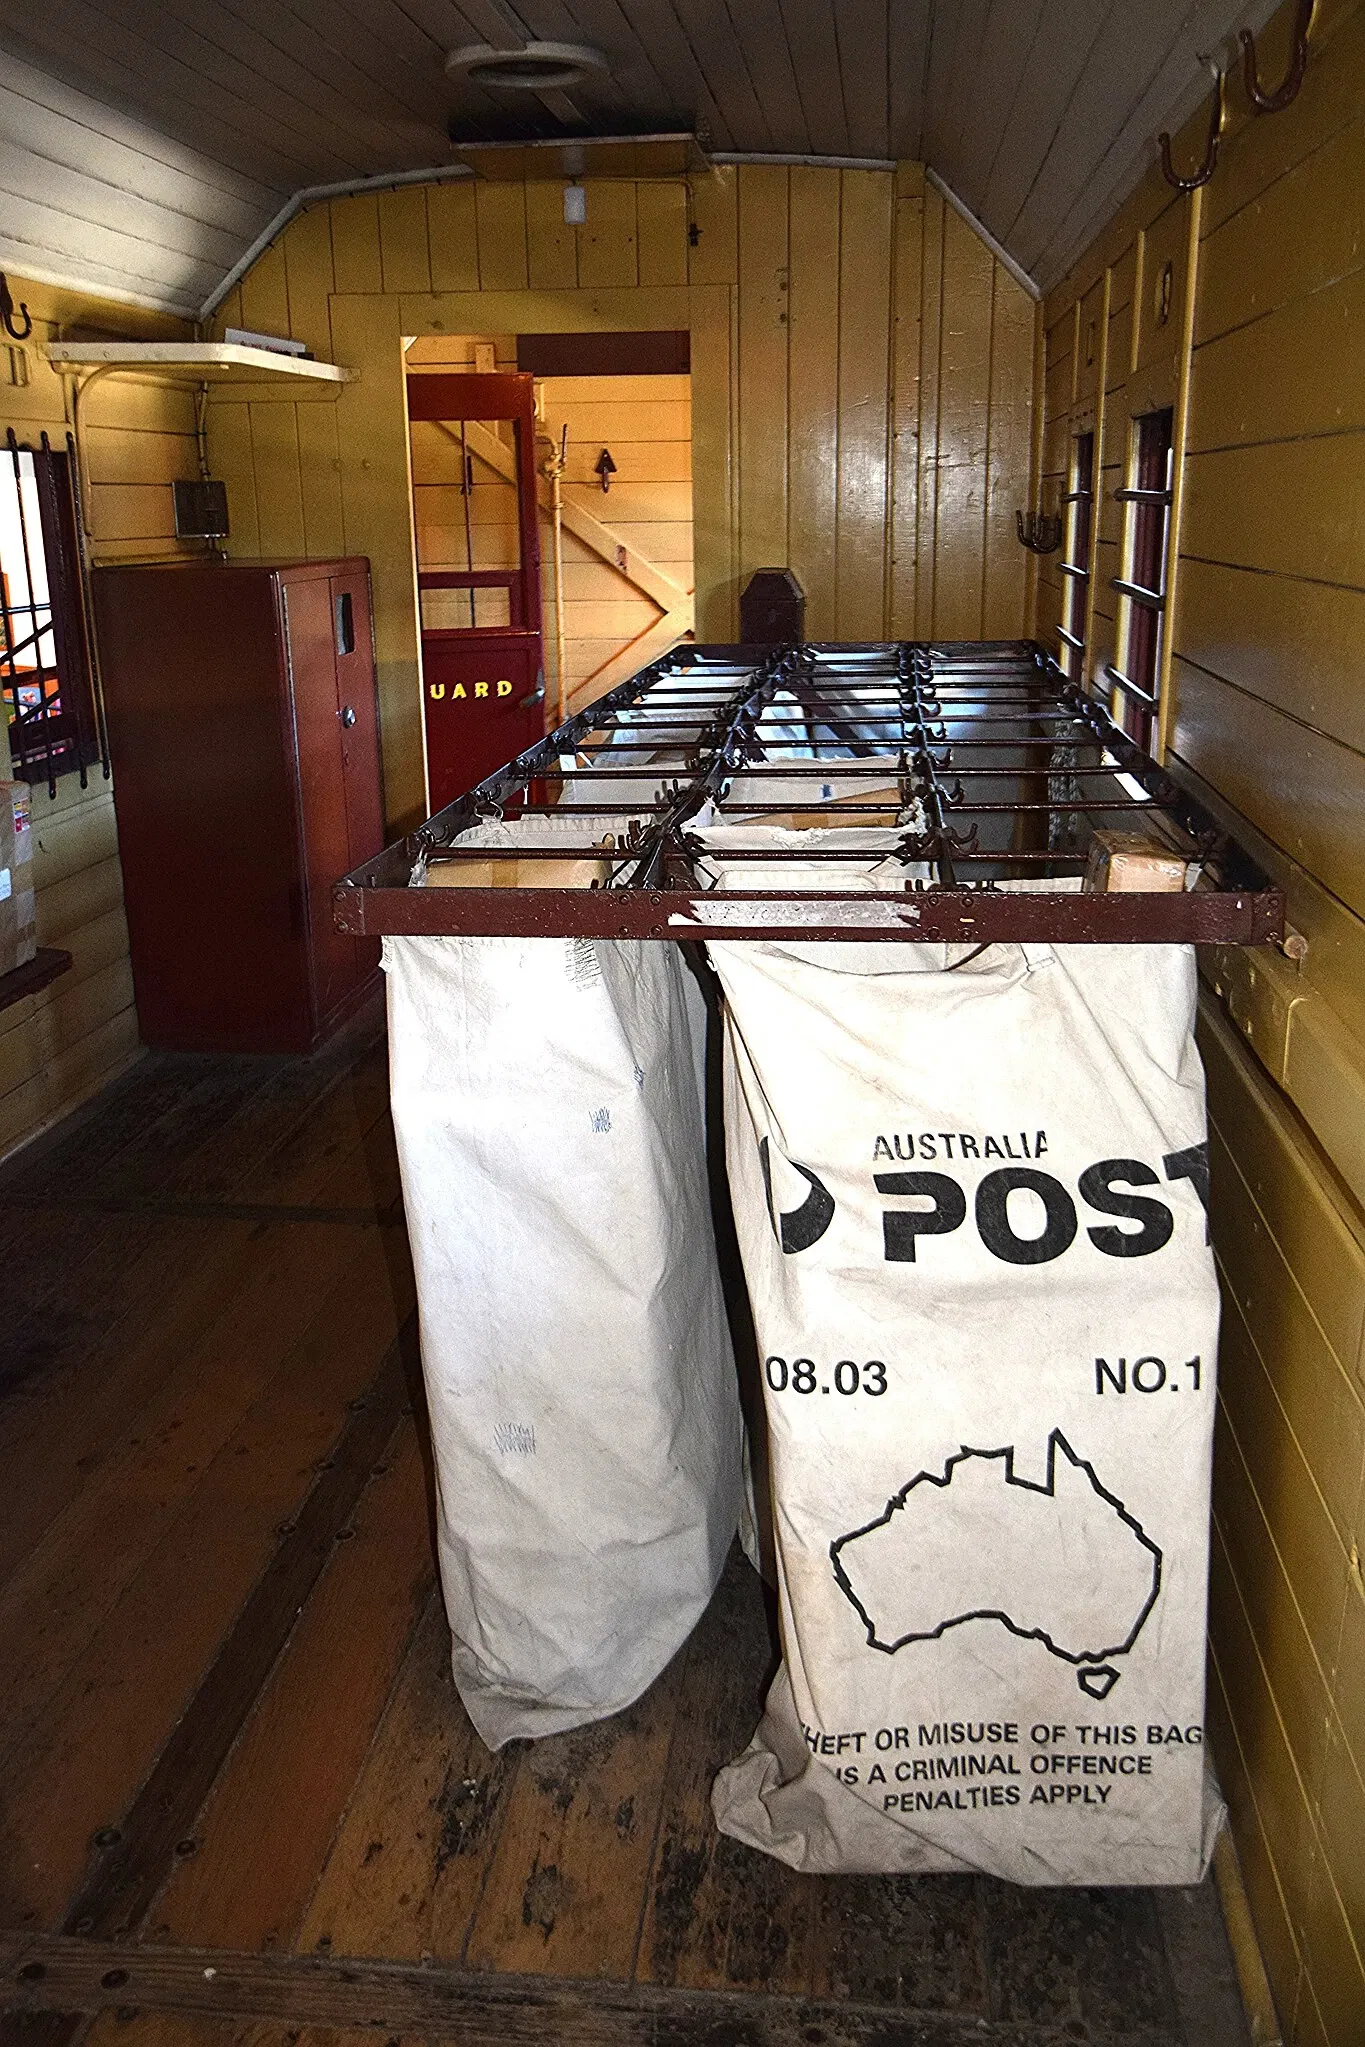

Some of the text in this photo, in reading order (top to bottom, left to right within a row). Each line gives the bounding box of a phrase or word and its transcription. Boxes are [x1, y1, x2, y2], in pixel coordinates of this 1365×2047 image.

[429, 680, 513, 700] UARD
[873, 1130, 1049, 1162] AUSTRALIA
[765, 1356, 889, 1396] 08.03
[1095, 1356, 1201, 1395] NO.1
[800, 1721, 1202, 1756] HEFT OR MISUSE OF THIS BAG
[835, 1753, 1152, 1786] IS A CRIMINAL OFFENCE
[883, 1784, 1112, 1812] PENALTIES APPLY
